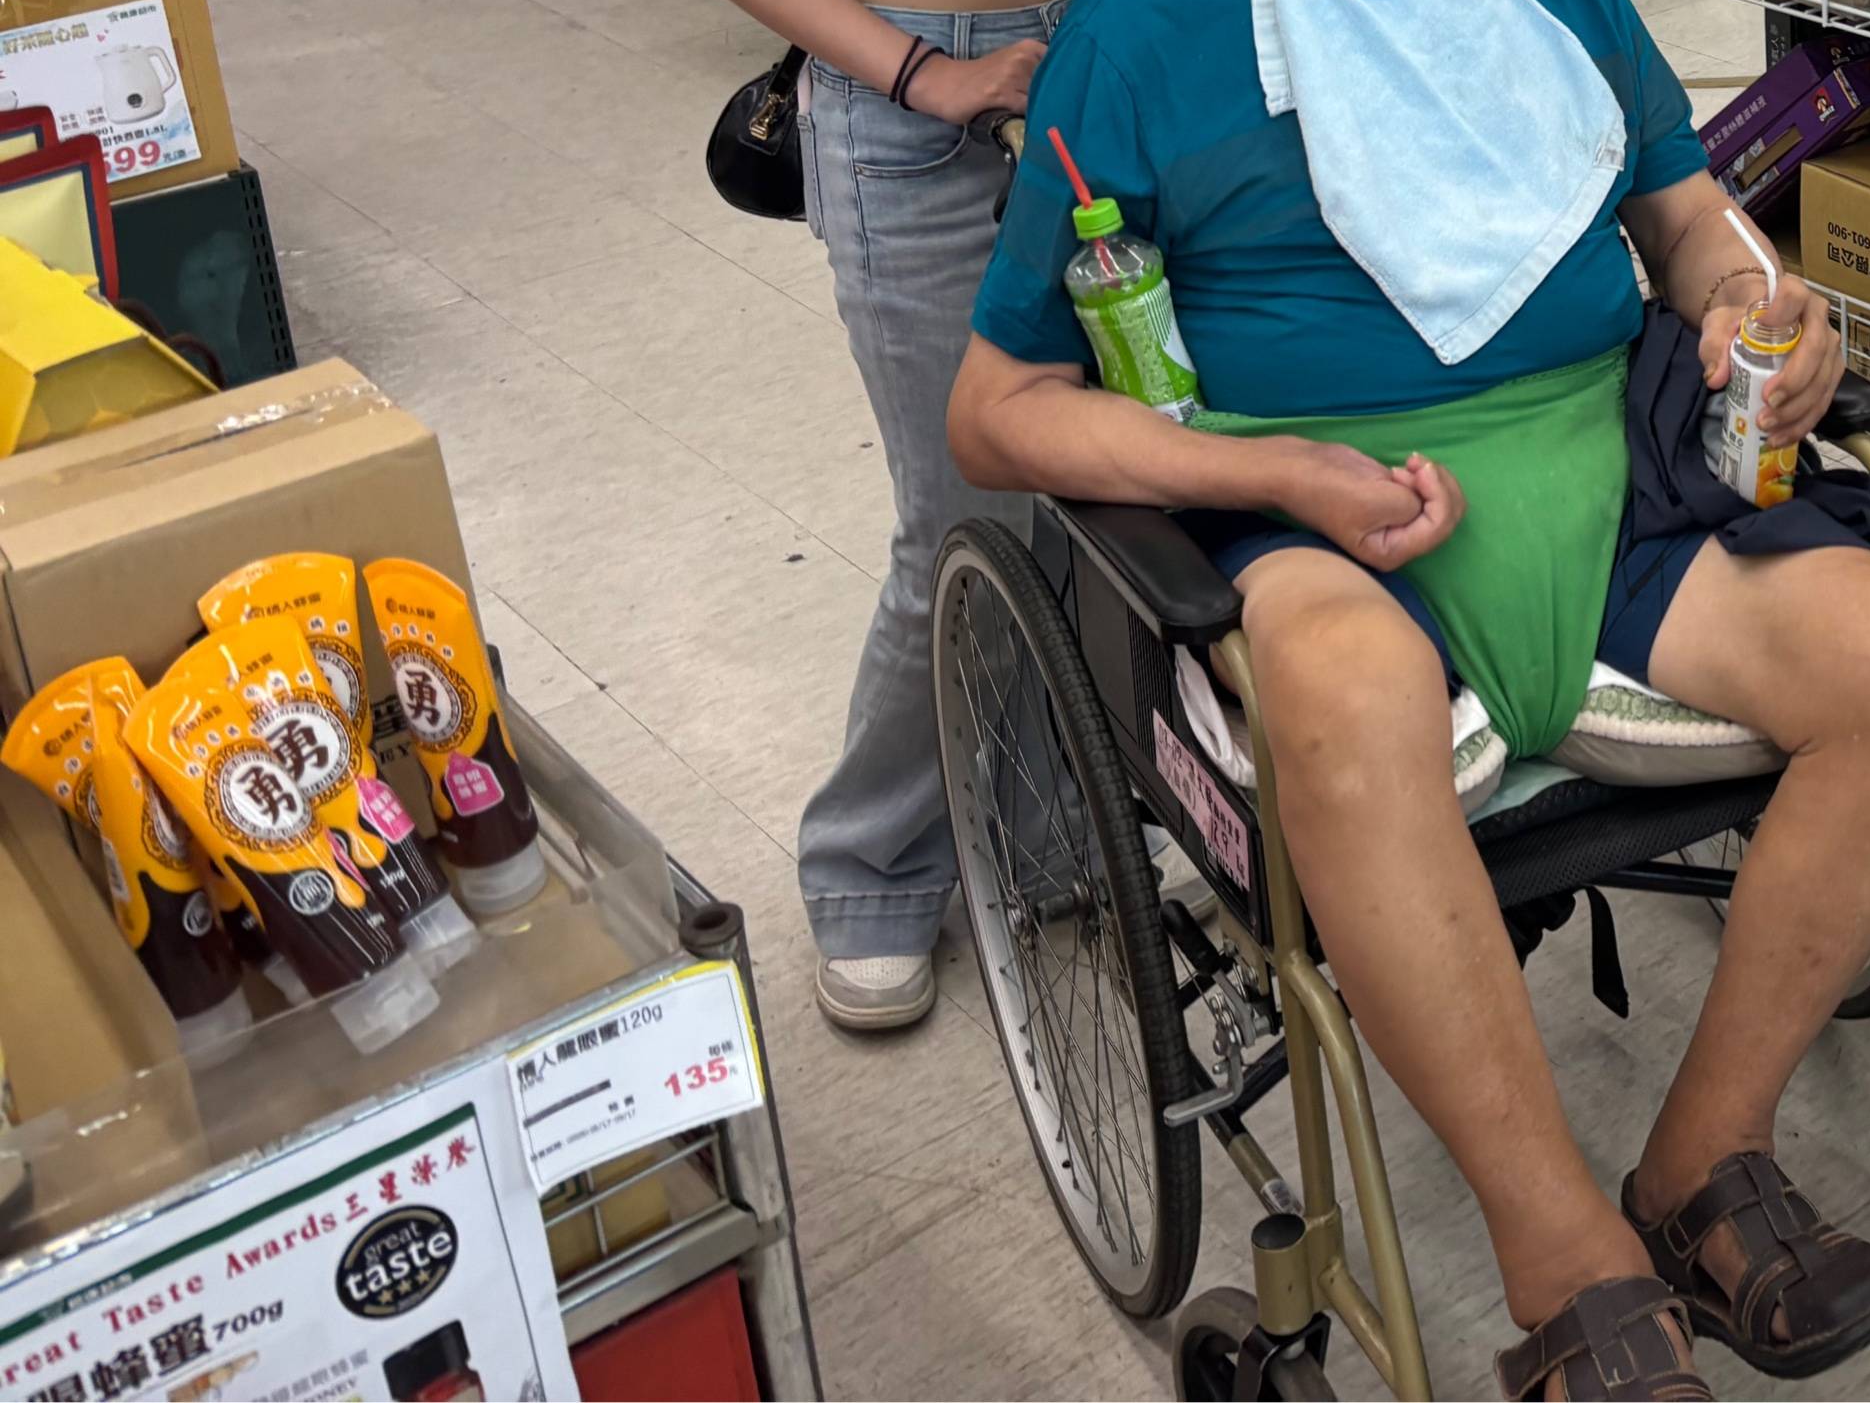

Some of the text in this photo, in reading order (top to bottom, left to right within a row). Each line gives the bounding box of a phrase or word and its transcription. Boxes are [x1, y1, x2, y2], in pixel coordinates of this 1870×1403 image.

[404, 668, 442, 729] 勇
[236, 765, 299, 826] 勇
[664, 1055, 729, 1098] 135
[345, 1235, 454, 1302] taste
[364, 1220, 421, 1265] great
[102, 1271, 206, 1336] Taste
[225, 1213, 338, 1280] Awards
[212, 1298, 285, 1343] 700g
